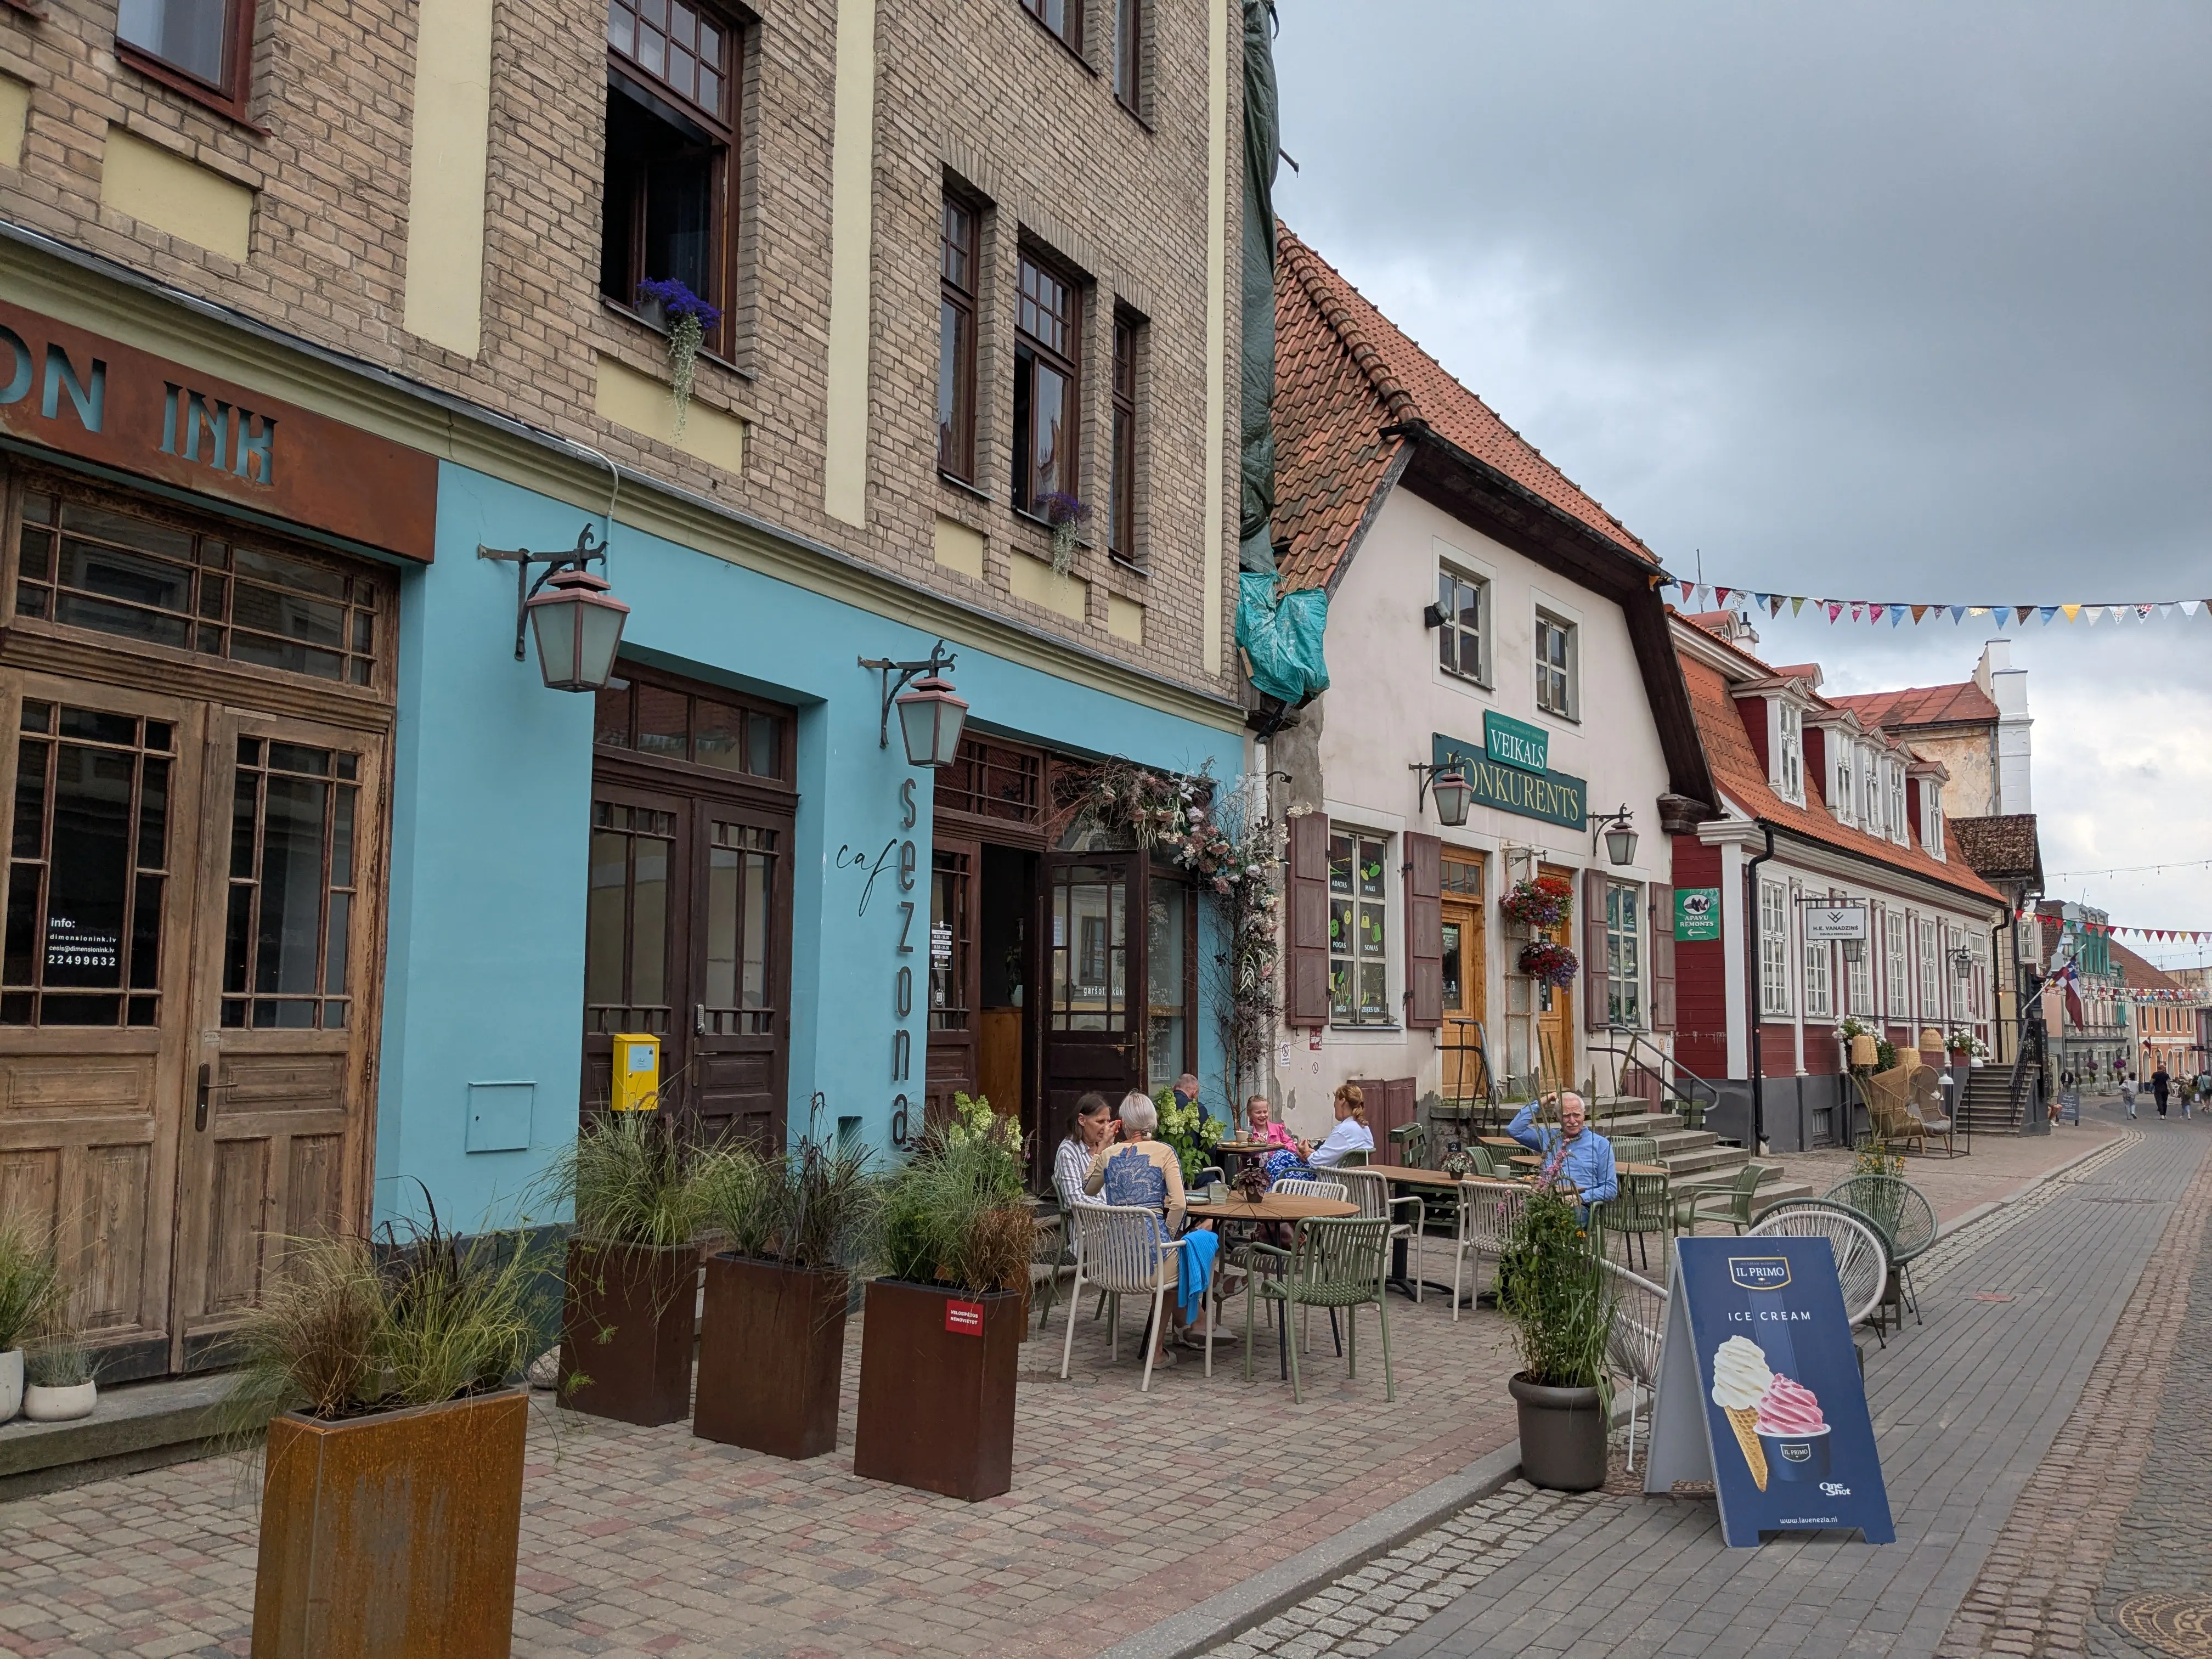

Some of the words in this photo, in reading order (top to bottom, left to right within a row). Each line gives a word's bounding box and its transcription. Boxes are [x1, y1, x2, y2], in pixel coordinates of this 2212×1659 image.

[1491, 729, 1544, 769] VEIKALS
[1331, 880, 1347, 888] ADATAS
[51, 917, 76, 928] info:
[49, 934, 117, 943] dimensionink.lv
[48, 955, 116, 967] 22499632
[892, 777, 917, 1146] sezona
[1247, 1158, 1254, 1166] 1
[1735, 1267, 1747, 1277] IL
[1748, 1267, 1785, 1277] PRIMO
[1728, 1312, 1753, 1322] ICE
[1760, 1311, 1812, 1321] CREAM
[1819, 1482, 1843, 1491] One
[1825, 1488, 1852, 1496] Shot
[1780, 1516, 1838, 1524] www.lavenezia.nl
